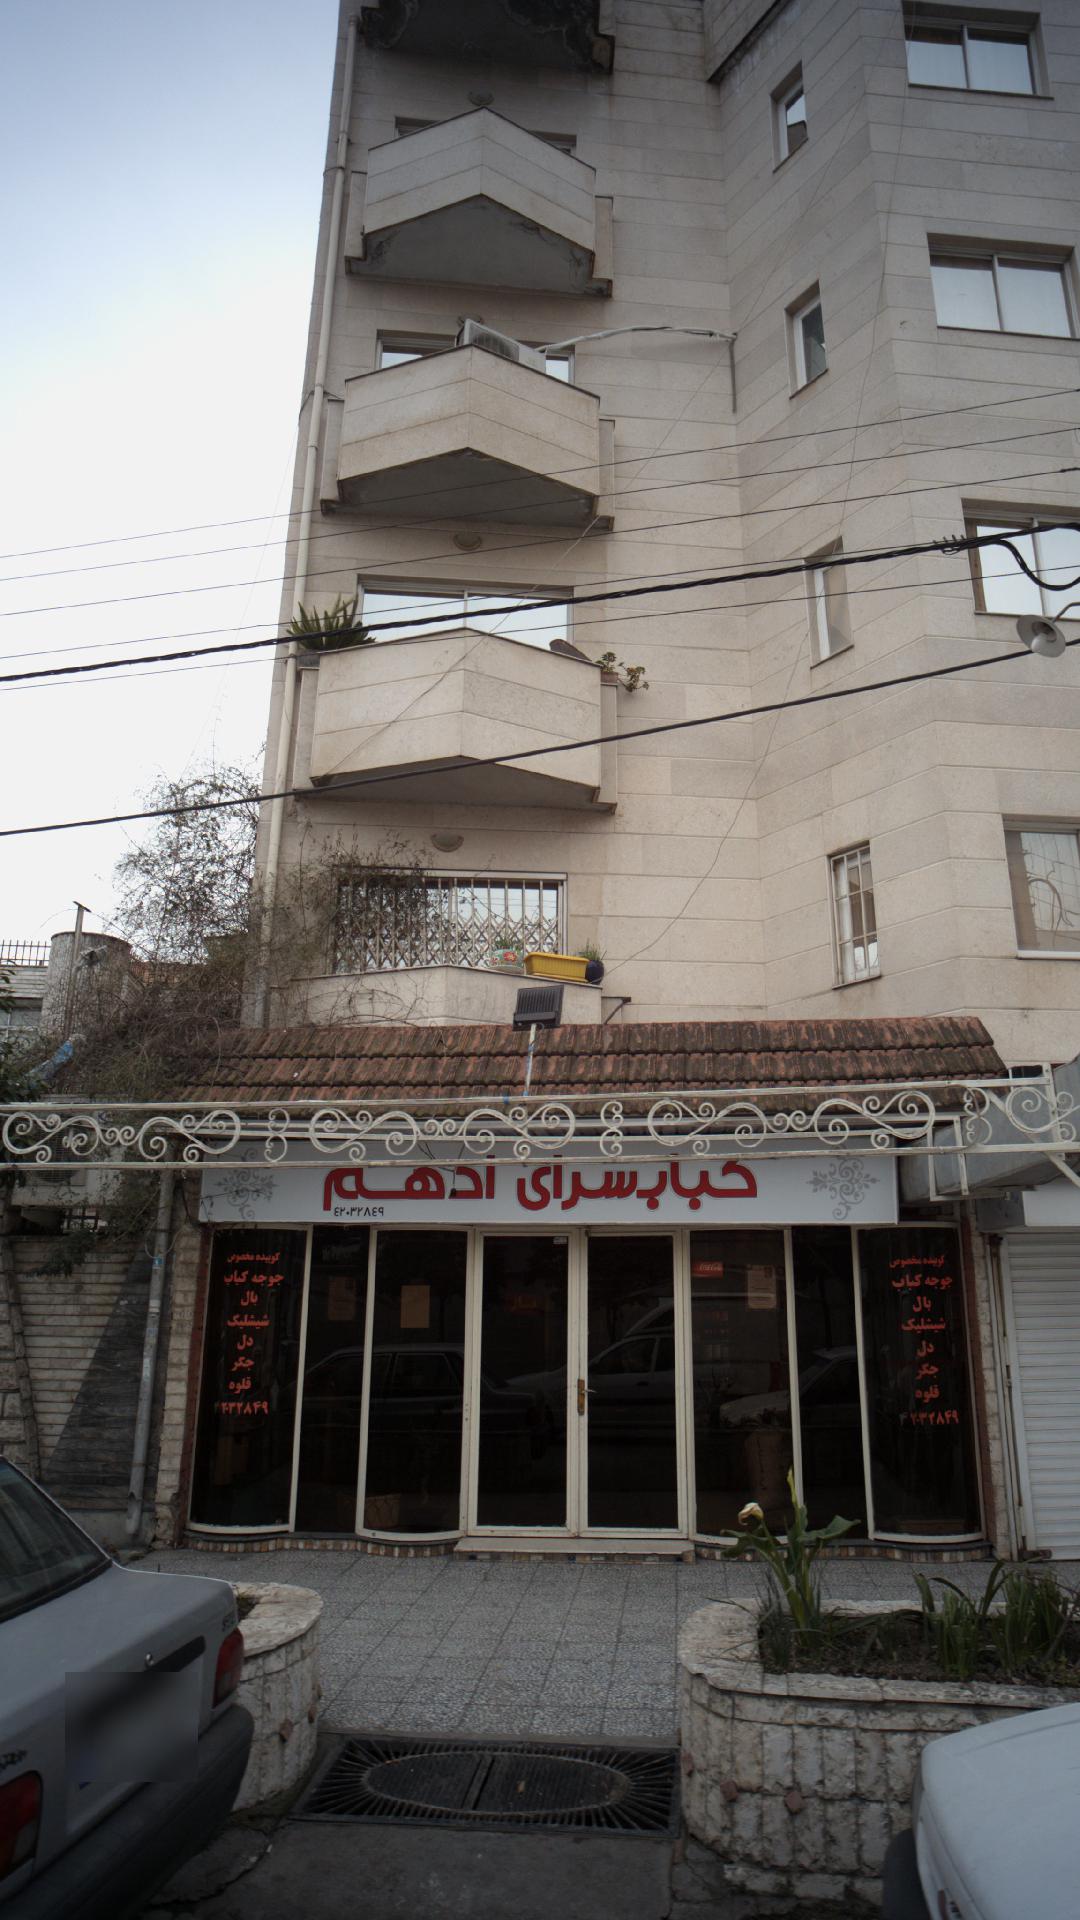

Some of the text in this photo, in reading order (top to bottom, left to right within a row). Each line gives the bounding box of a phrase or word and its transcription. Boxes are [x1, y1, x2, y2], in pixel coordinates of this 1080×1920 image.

[323, 1154, 496, 1212] ادهم
[224, 1270, 285, 1288] جوجه کباب
[892, 1273, 953, 1292] جوجه کباب
[240, 1290, 259, 1306] بال
[912, 1295, 932, 1312] بال
[226, 1314, 271, 1330] شیشلیک
[901, 1318, 946, 1335] شیشلیک
[236, 1334, 254, 1351] دل
[917, 1340, 934, 1357] دل
[228, 1377, 252, 1395] قلوه
[915, 1384, 940, 1403] قلوه
